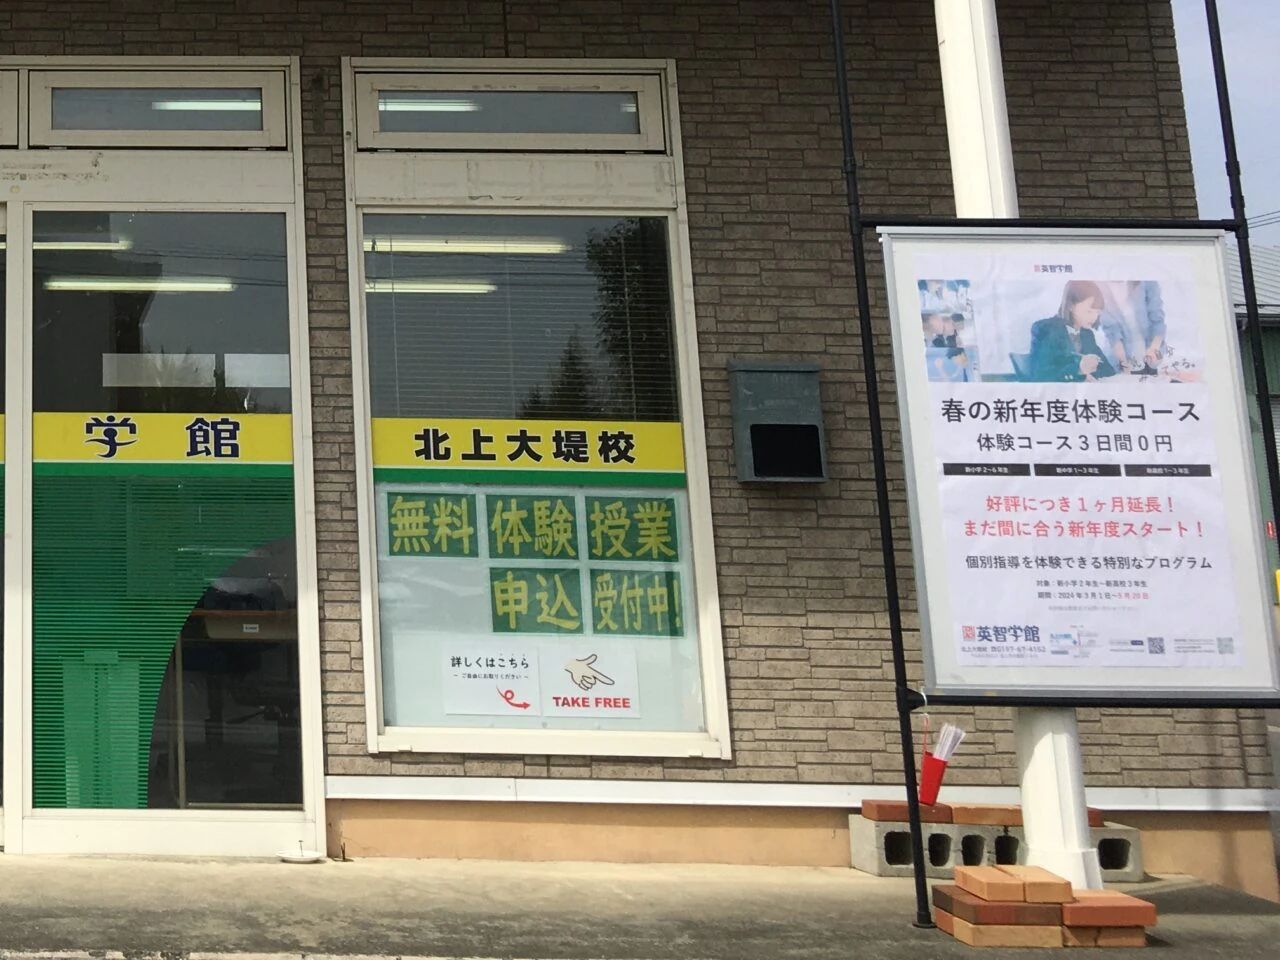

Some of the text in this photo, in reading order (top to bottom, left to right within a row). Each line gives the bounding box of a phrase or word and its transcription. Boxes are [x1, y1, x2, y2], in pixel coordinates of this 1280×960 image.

[941, 398, 1201, 424] 春の新年度体験コース
[414, 427, 637, 464] 北上大堤校
[963, 520, 1204, 538] まだ間に合う新年度スタート！
[965, 555, 1213, 570] 個別指導を体験できる特別なプログラム
[976, 625, 1041, 643] 英智学館
[450, 655, 530, 669] 詳しくはこちら
[552, 696, 631, 709] TAKE FREE
